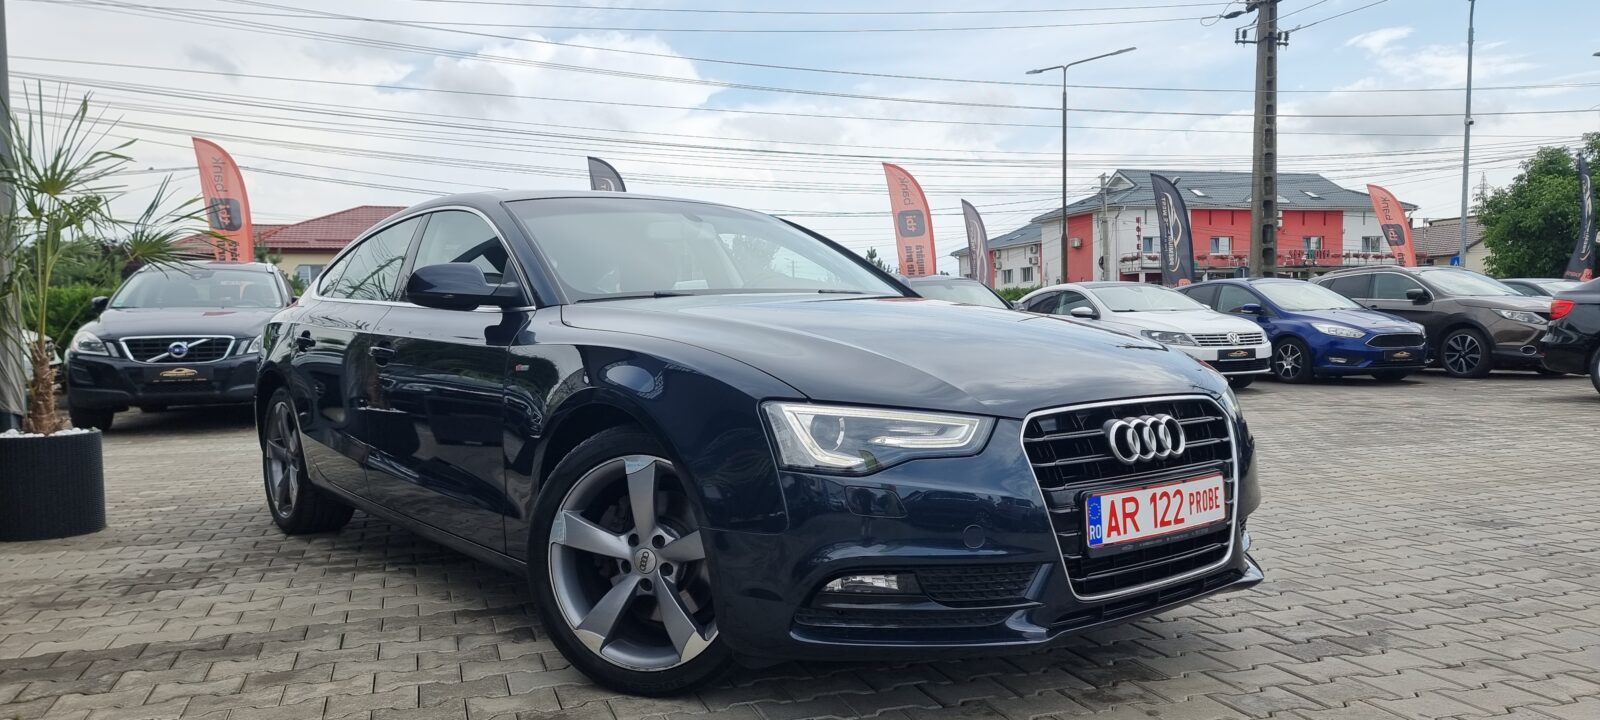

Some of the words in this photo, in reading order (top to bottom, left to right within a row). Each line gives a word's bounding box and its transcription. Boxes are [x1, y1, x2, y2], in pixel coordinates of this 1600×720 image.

[1107, 496, 1140, 538] AR
[1150, 489, 1185, 528] 122
[1189, 487, 1220, 515] PROBE
[1090, 524, 1102, 540] RO
